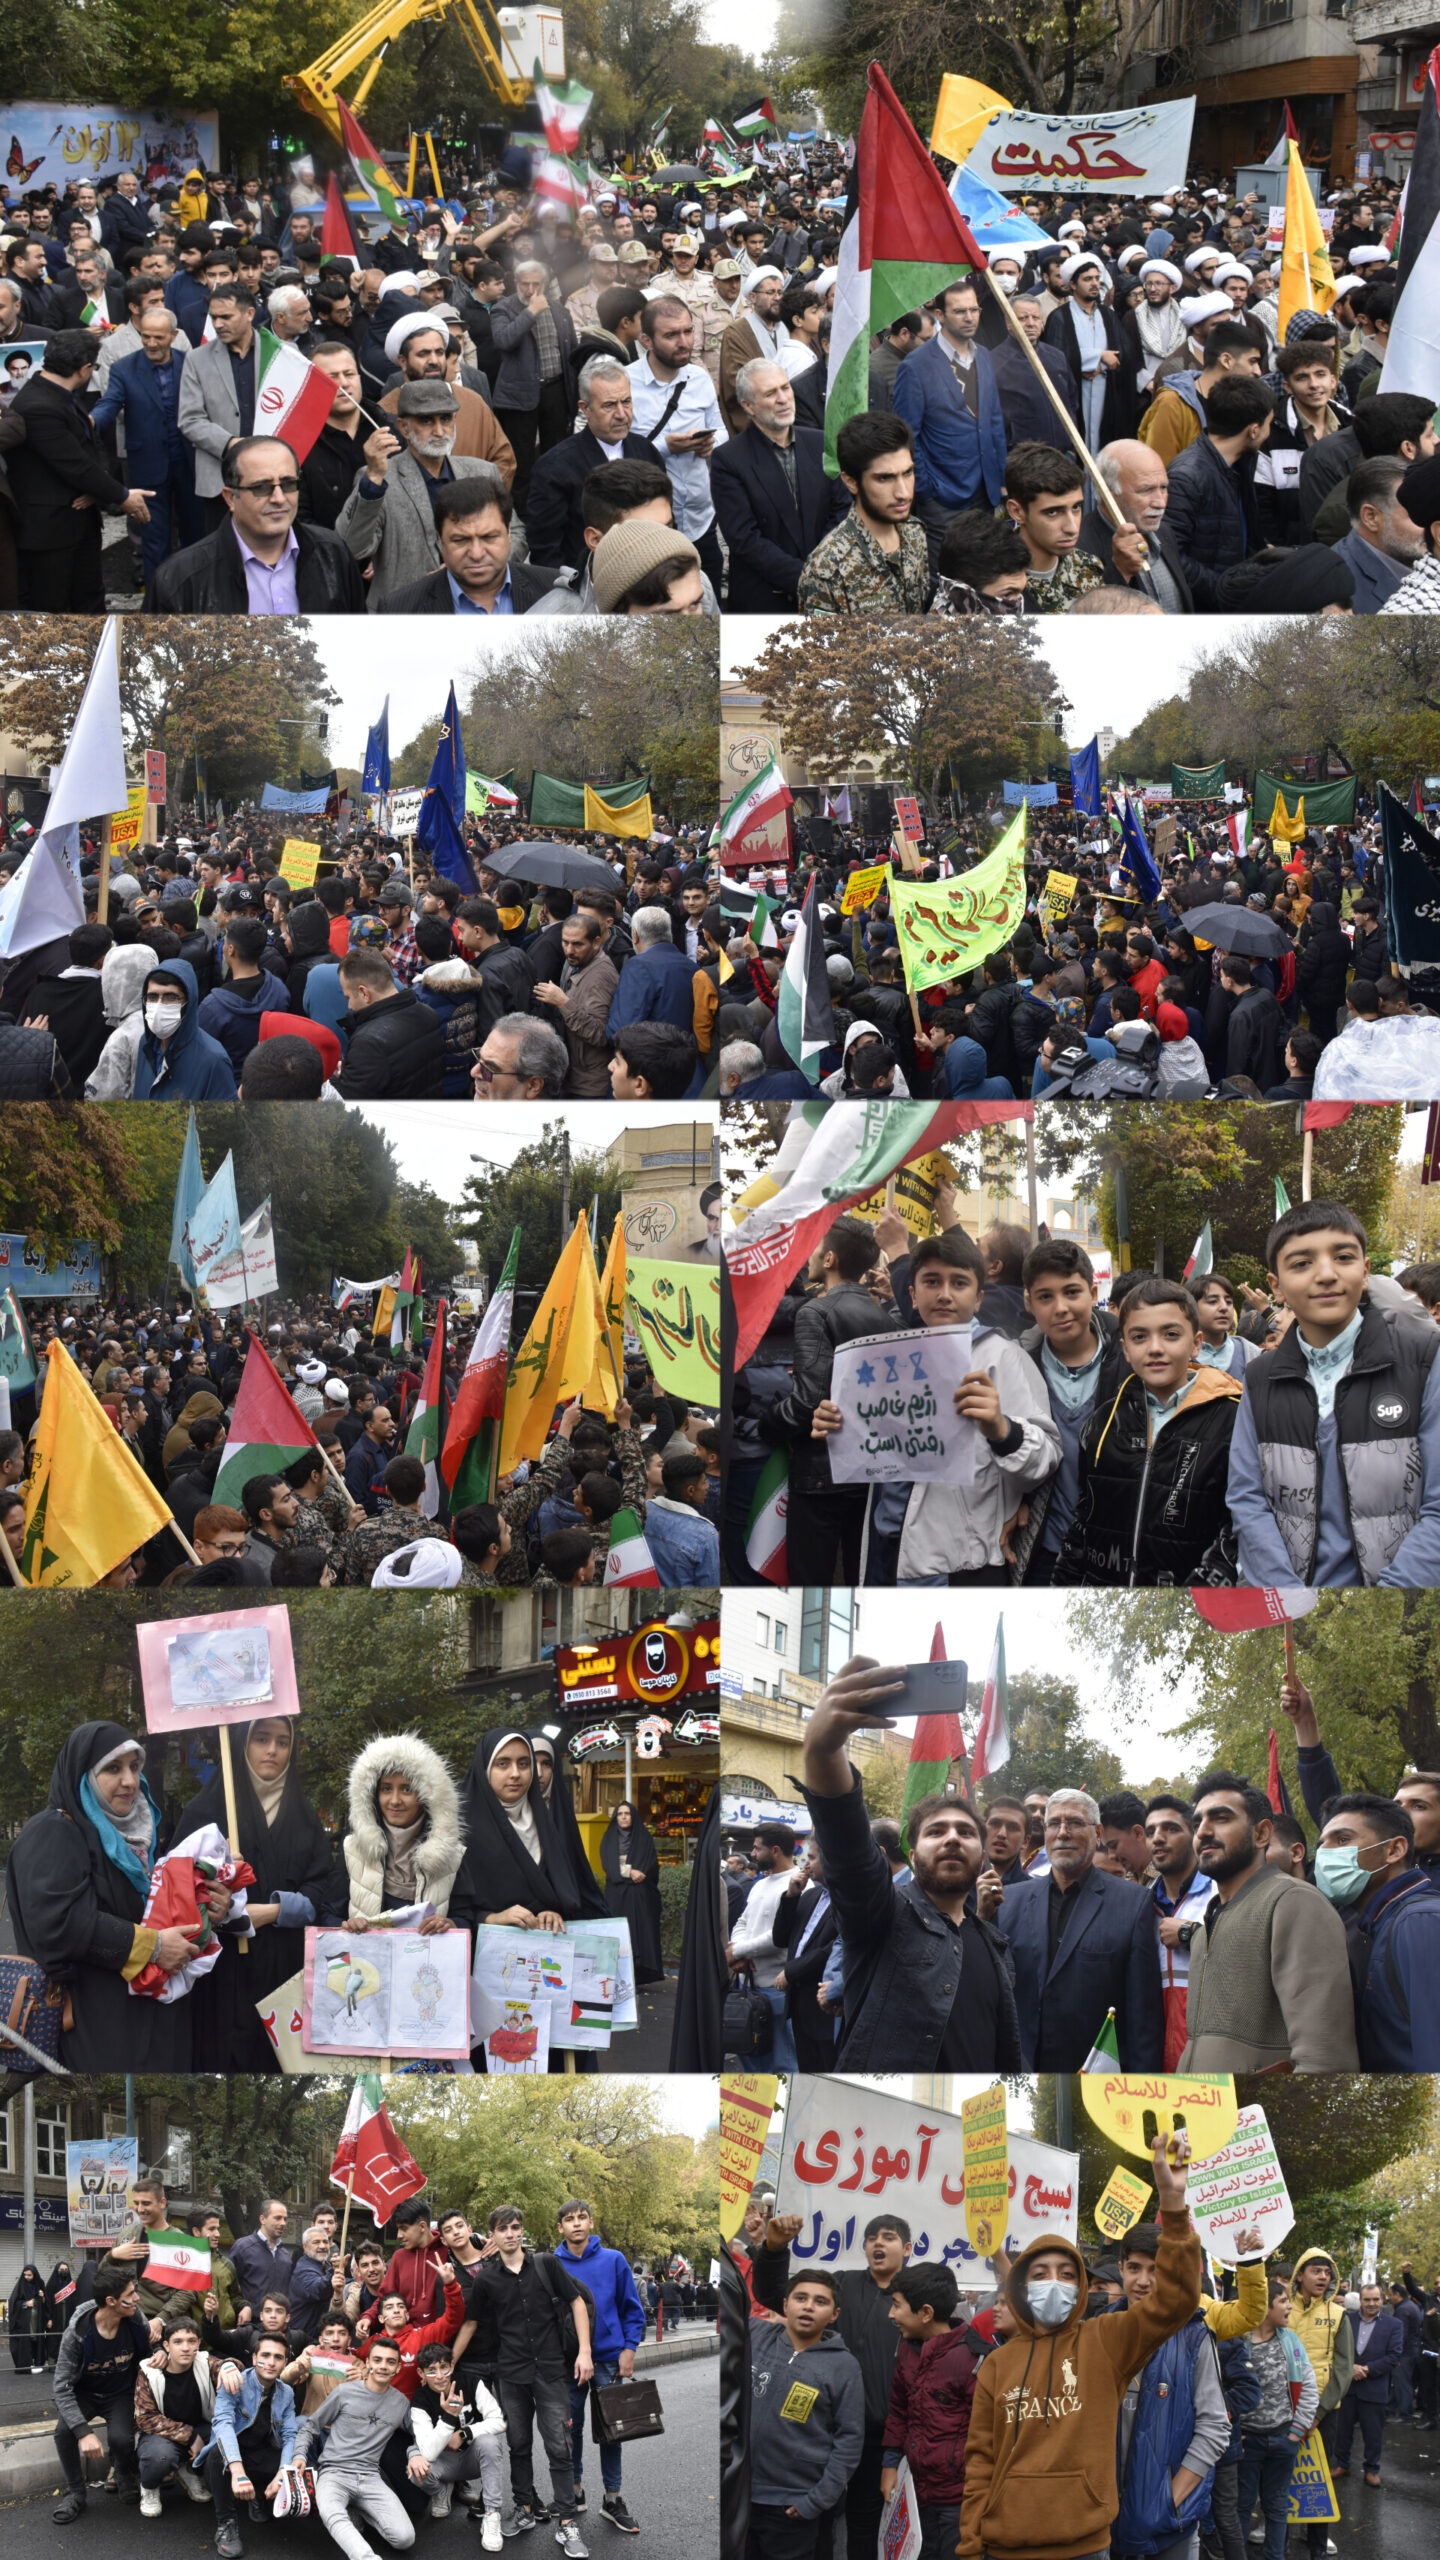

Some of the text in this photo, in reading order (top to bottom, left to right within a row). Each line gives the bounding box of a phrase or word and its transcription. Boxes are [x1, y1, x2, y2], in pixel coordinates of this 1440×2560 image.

[1071, 111, 1159, 134] هنرستان
[62, 120, 114, 172] آبان
[991, 132, 1148, 180] حکمت
[112, 825, 135, 840] USA
[901, 1173, 922, 1191] WITH
[857, 1390, 906, 1427] غاصب
[1377, 1404, 1403, 1418] Sup
[905, 1425, 945, 1458] رفتنی
[560, 1652, 617, 1687] بستنی
[639, 1673, 678, 1689] کاپتان هوسا
[572, 1690, 586, 1699] 0930
[728, 1804, 797, 1826] شهریار
[729, 2073, 759, 2094] الله اکبر
[1103, 2077, 1168, 2104] للاسلام
[738, 2118, 761, 2134] الموت
[1238, 2126, 1264, 2140] U.S.A
[726, 2128, 761, 2152] WITH U.S.A
[793, 2122, 941, 2195] آموزی
[1189, 2137, 1267, 2173] الموت لامریکا
[730, 2171, 749, 2191] ISRAEL
[1188, 2153, 1274, 2186] DOWN WITH ISRAEL
[1023, 2173, 1073, 2222] بسیج
[1194, 2166, 1278, 2204] الموت لاسرائیل
[1200, 2184, 1277, 2214] Victory to Islam
[39, 2211, 67, 2223] عینک
[1103, 2203, 1132, 2226] USA
[1208, 2207, 1248, 2236] للاسلام
[791, 2210, 857, 2263] اول
[1313, 2317, 1337, 2328] BTS
[1001, 2395, 1083, 2424] FRANCE
